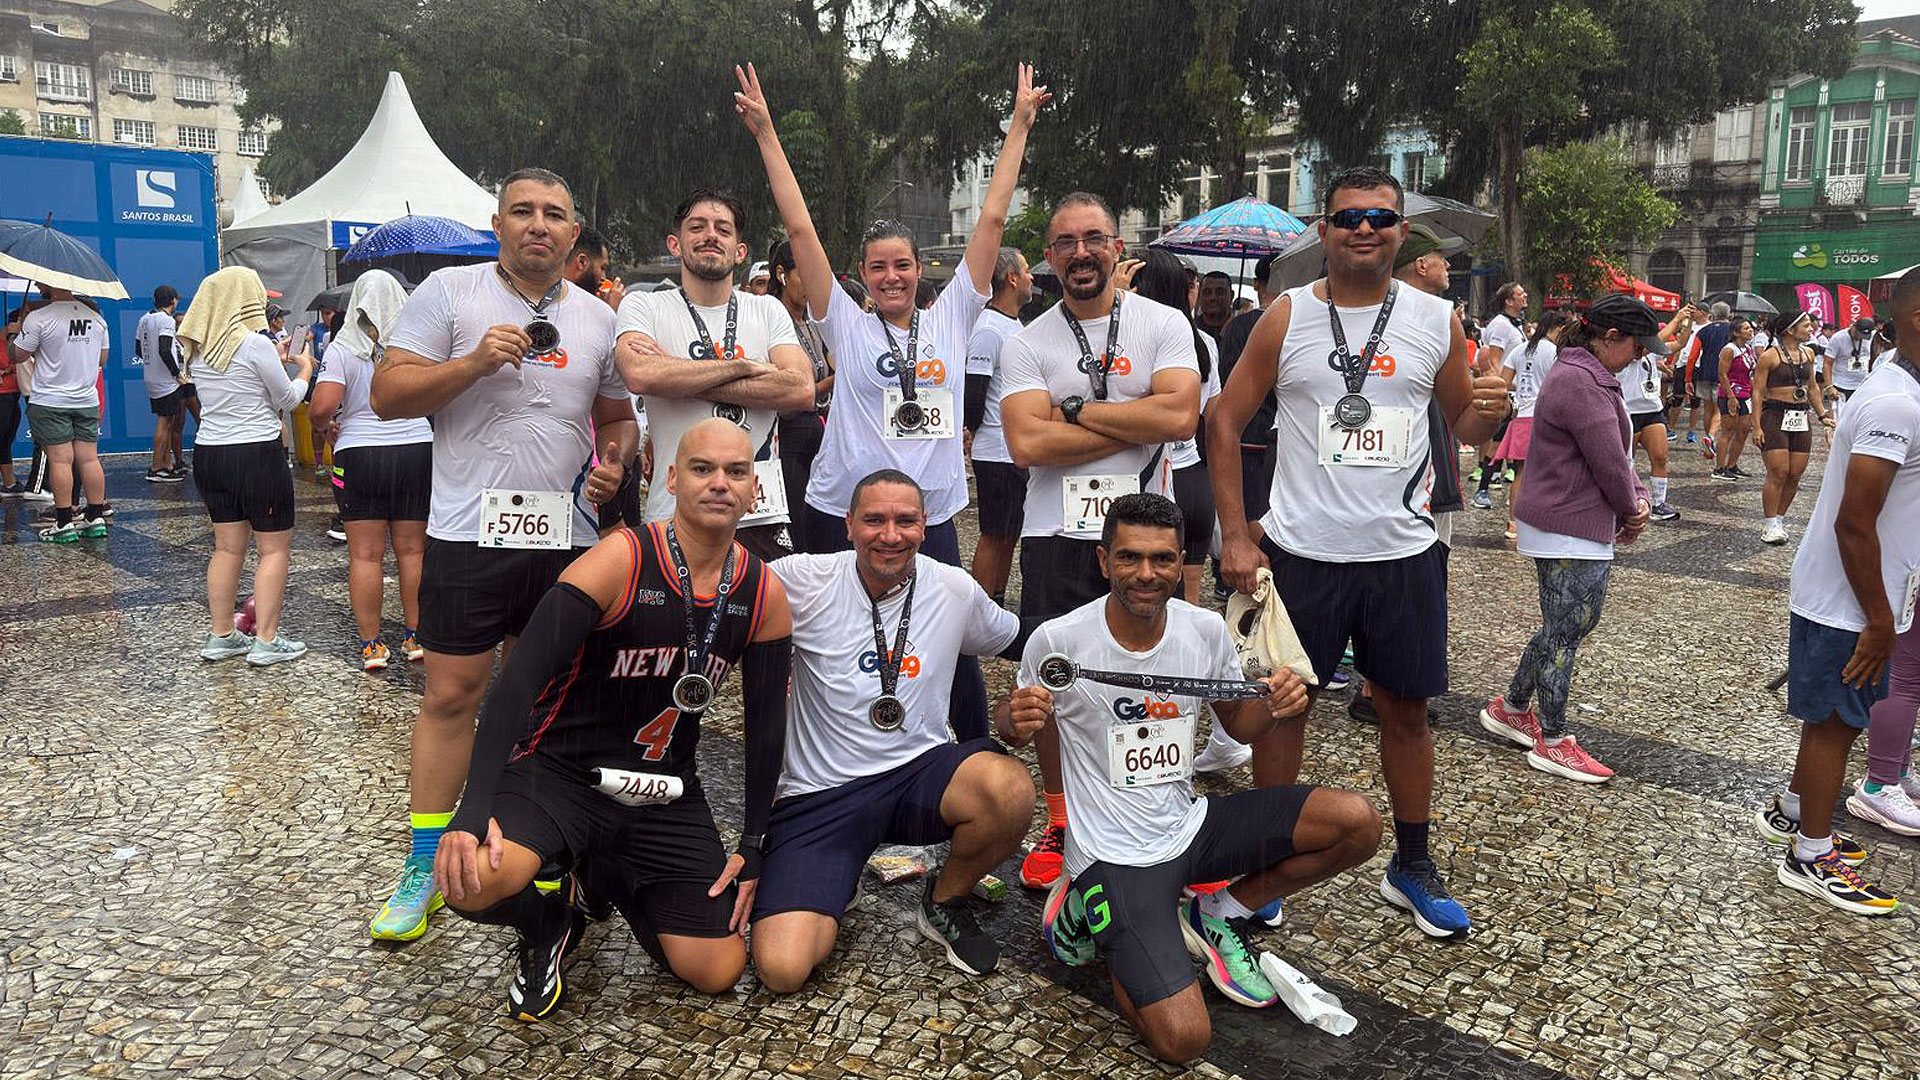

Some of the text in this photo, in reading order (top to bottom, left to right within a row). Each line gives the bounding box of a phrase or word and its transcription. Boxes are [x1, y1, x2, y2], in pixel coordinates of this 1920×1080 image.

[122, 211, 194, 223] SANTOS BRASIL
[1833, 255, 1879, 264] TODOS
[1341, 429, 1384, 451] 7181
[1080, 496, 1112, 518] 710
[487, 522, 495, 533] F
[498, 513, 549, 535] 5766
[610, 646, 680, 679] NEW
[633, 706, 681, 762] 4
[1125, 743, 1180, 772] 6640
[614, 776, 669, 799] 7448
